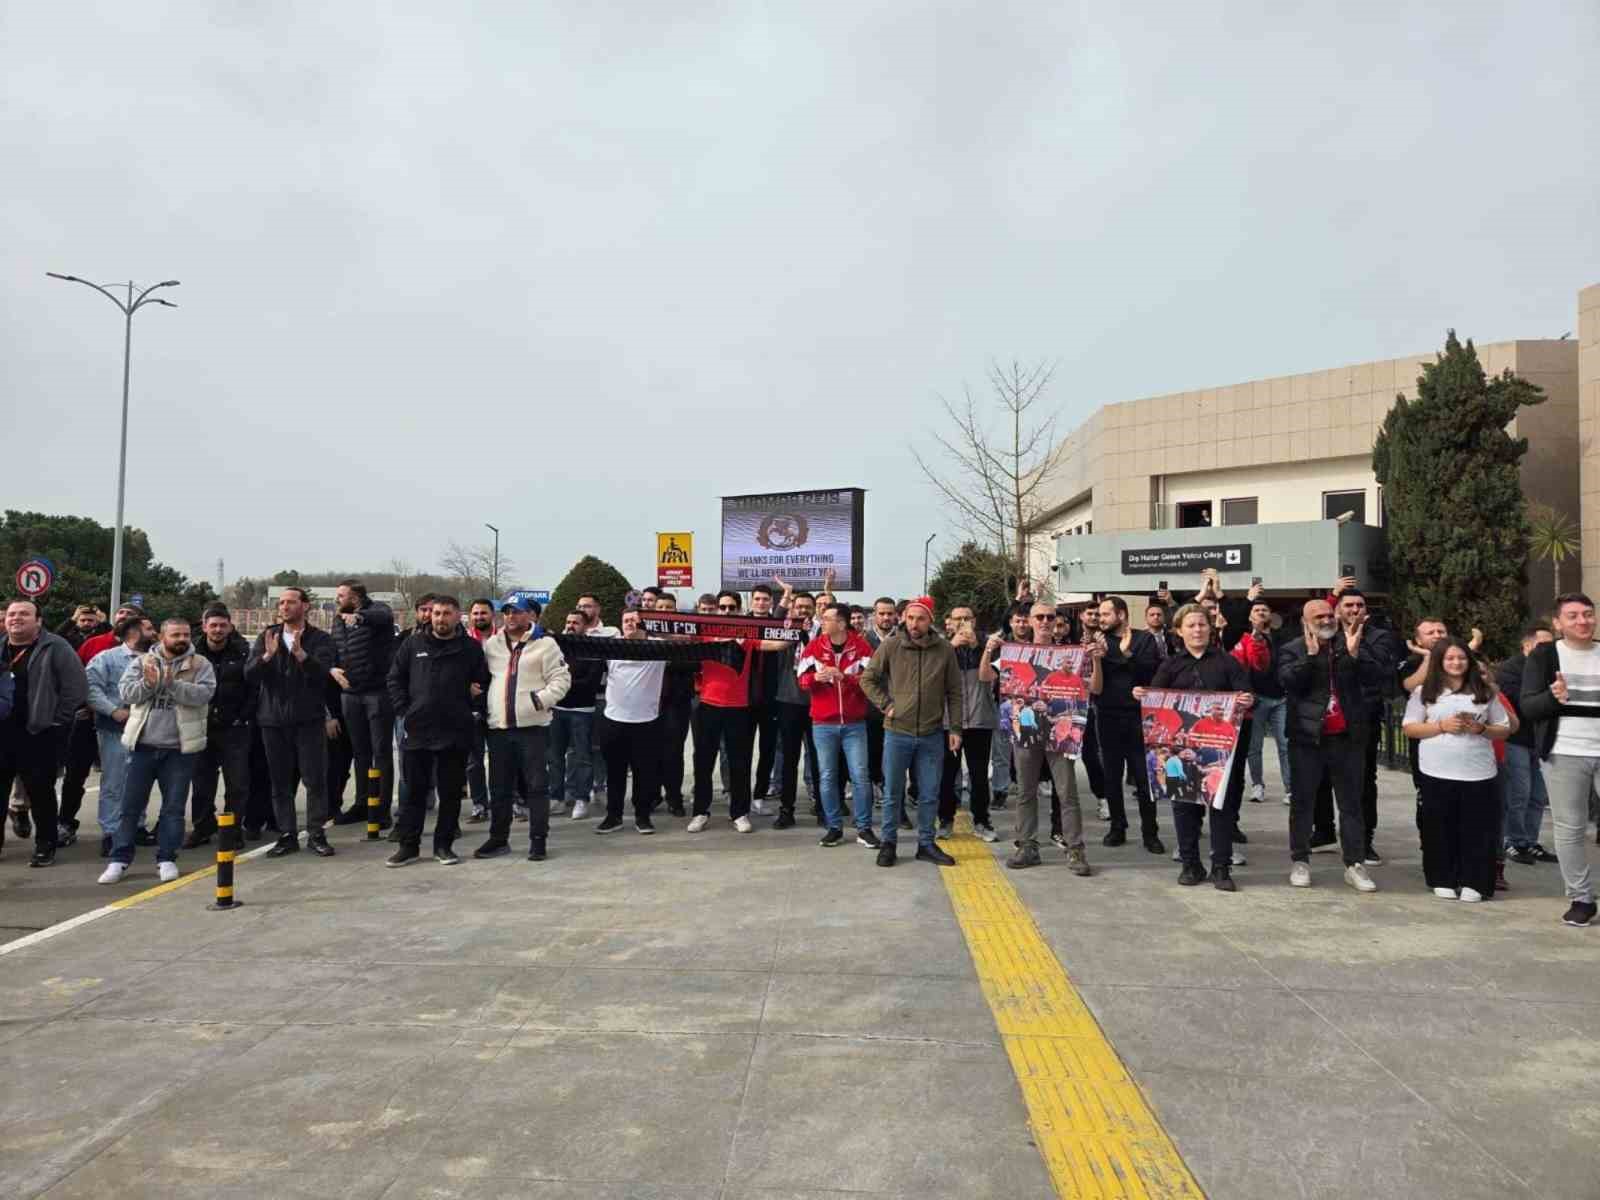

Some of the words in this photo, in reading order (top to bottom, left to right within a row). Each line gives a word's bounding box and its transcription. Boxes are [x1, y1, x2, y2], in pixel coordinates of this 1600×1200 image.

[739, 556, 768, 564] THANKS
[769, 555, 784, 564] FOR
[786, 553, 834, 564] EVERYTHING
[764, 627, 800, 641] ENEMIES
